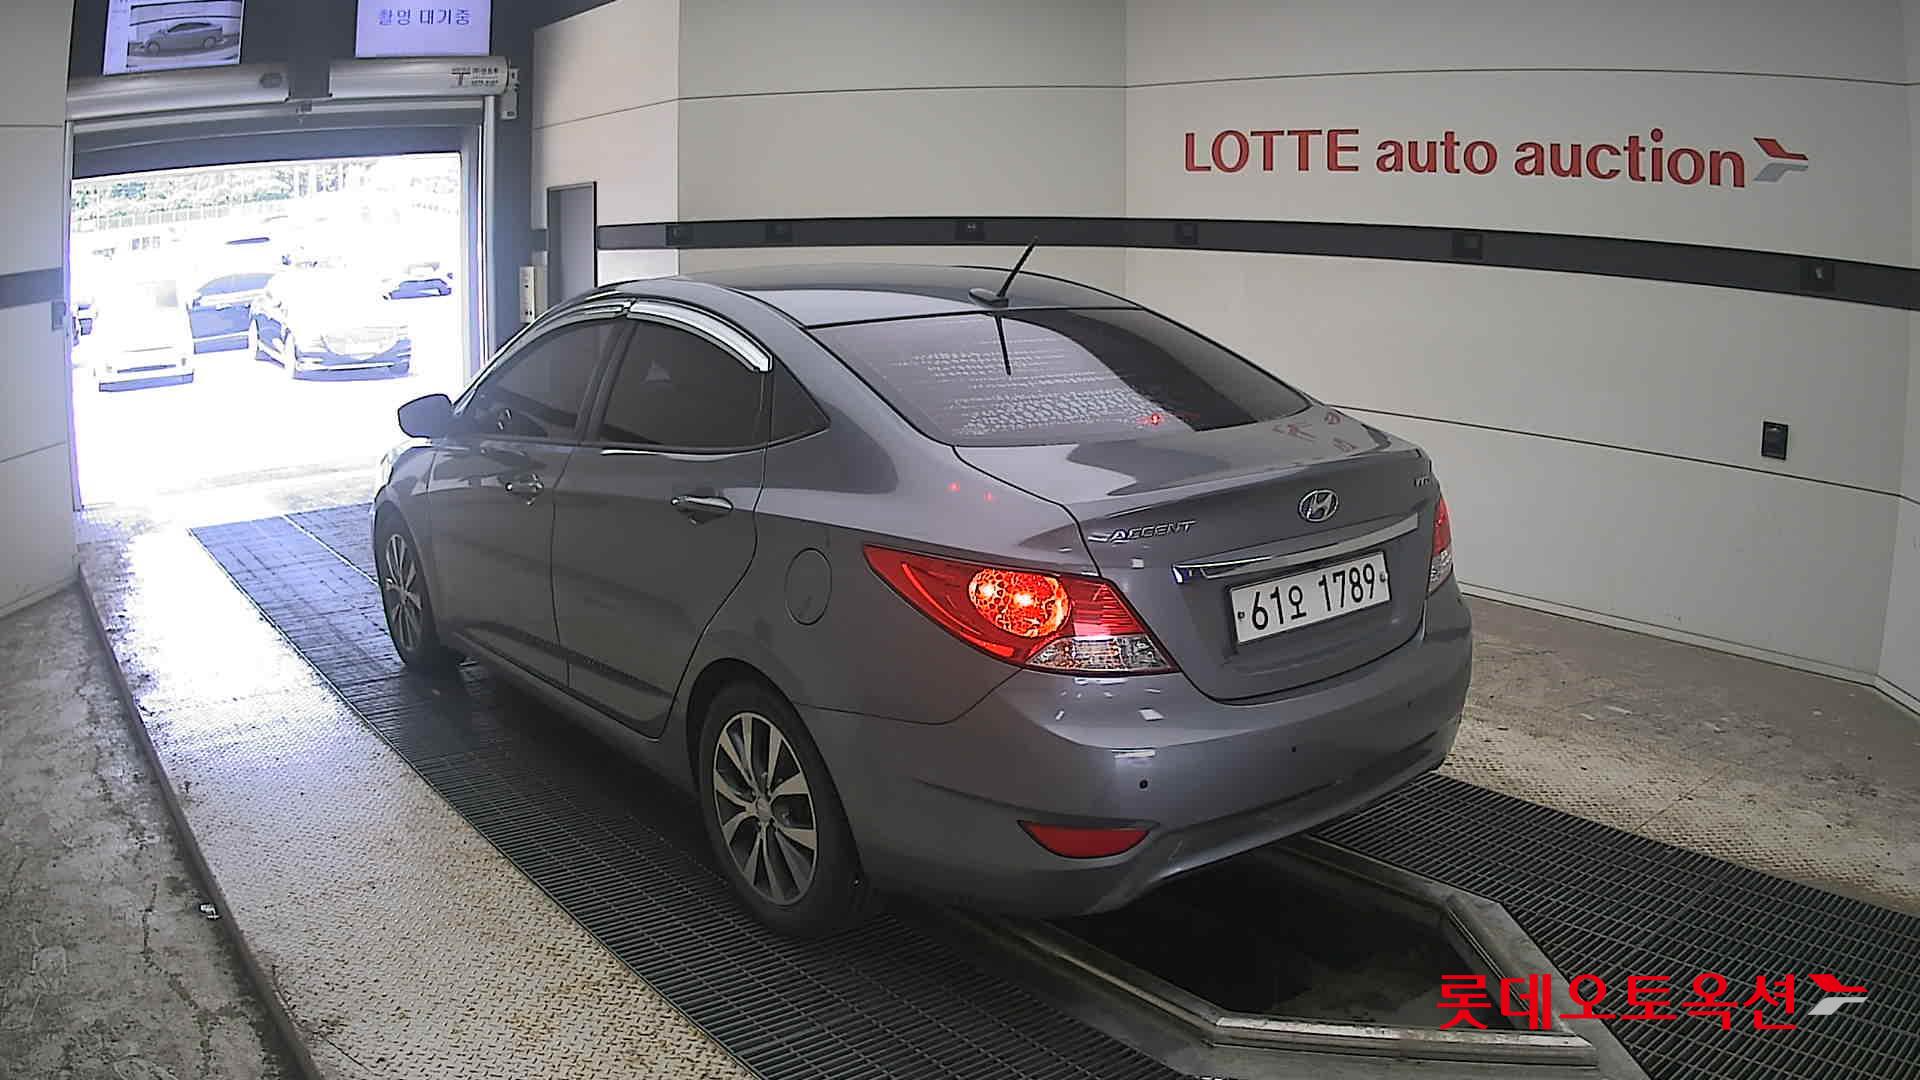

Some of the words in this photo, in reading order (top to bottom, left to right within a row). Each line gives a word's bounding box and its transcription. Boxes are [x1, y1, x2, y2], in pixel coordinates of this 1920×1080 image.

[420, 8, 470, 26] 대기중
[1184, 128, 1360, 173] LOTTE
[1376, 131, 1498, 176] auto
[1514, 128, 1746, 189] auction
[1109, 519, 1197, 544] ACCENT
[1251, 585, 1307, 631] 61오
[1317, 562, 1376, 612] 1789
